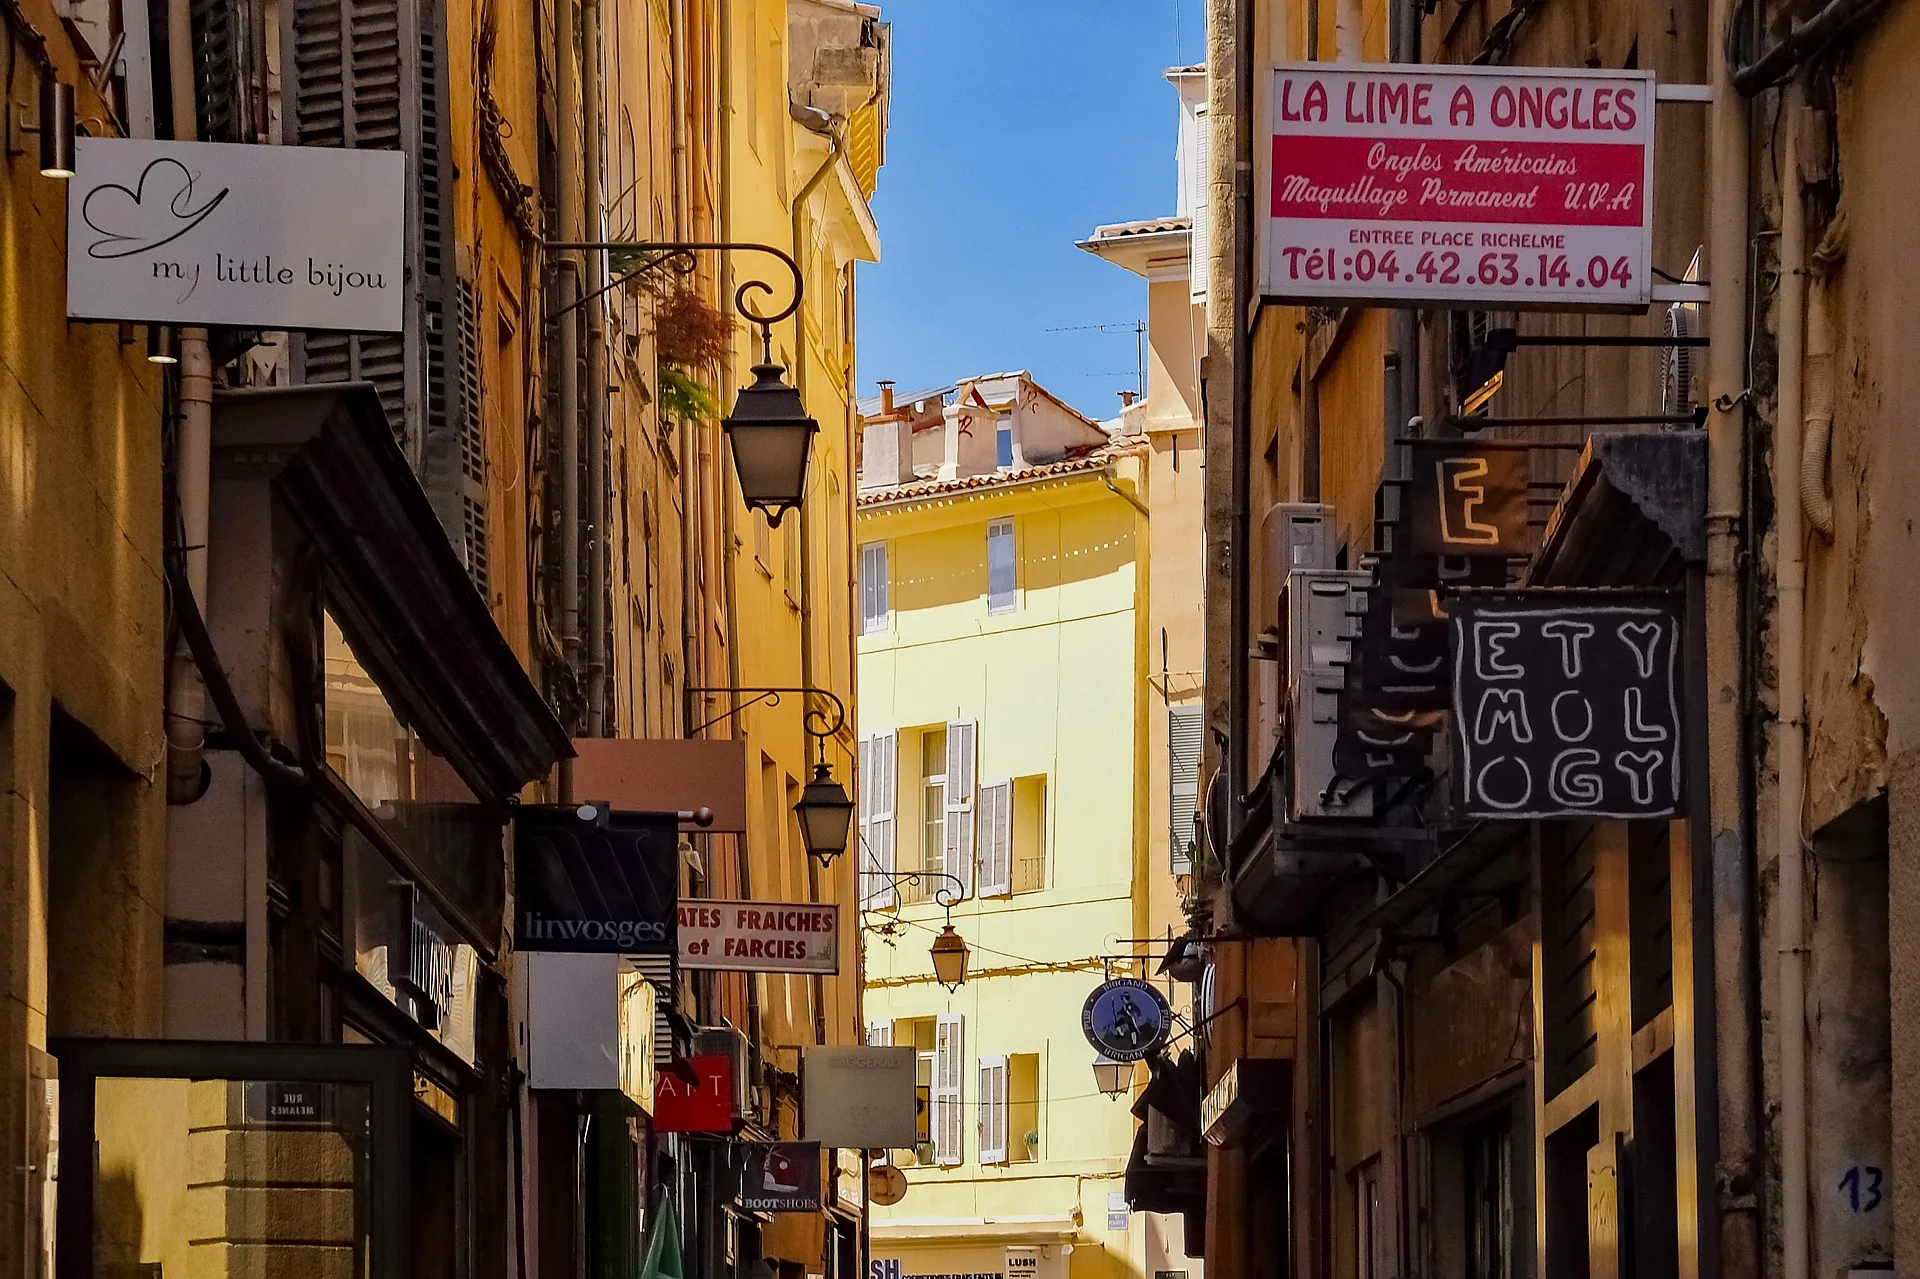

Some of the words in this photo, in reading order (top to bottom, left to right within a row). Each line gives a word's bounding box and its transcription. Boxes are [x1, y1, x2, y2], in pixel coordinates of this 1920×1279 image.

[1281, 80, 1328, 122] LA
[1345, 81, 1433, 126] LIME
[1450, 84, 1475, 127] A
[1490, 86, 1637, 132] ONGLES
[1366, 142, 1442, 181] Ongles
[1453, 144, 1577, 174] Américains
[1280, 175, 1408, 216] Maquillage
[1420, 177, 1539, 208] Permanent
[1563, 182, 1636, 211] U.V.A
[1349, 229, 1414, 245] ENTREE
[1420, 232, 1474, 248] PLACE
[1480, 233, 1565, 250] RICHELME
[152, 258, 200, 304] my
[216, 253, 294, 285] little
[308, 257, 387, 297] bijou
[525, 911, 667, 947] linvosges
[737, 908, 833, 933] FRAICHES
[688, 938, 709, 956] et
[724, 938, 806, 960] FARCIES
[1102, 979, 1148, 991] BRIGAND
[1838, 1166, 1883, 1213] 13
[1008, 1258, 1037, 1267] LUSH
